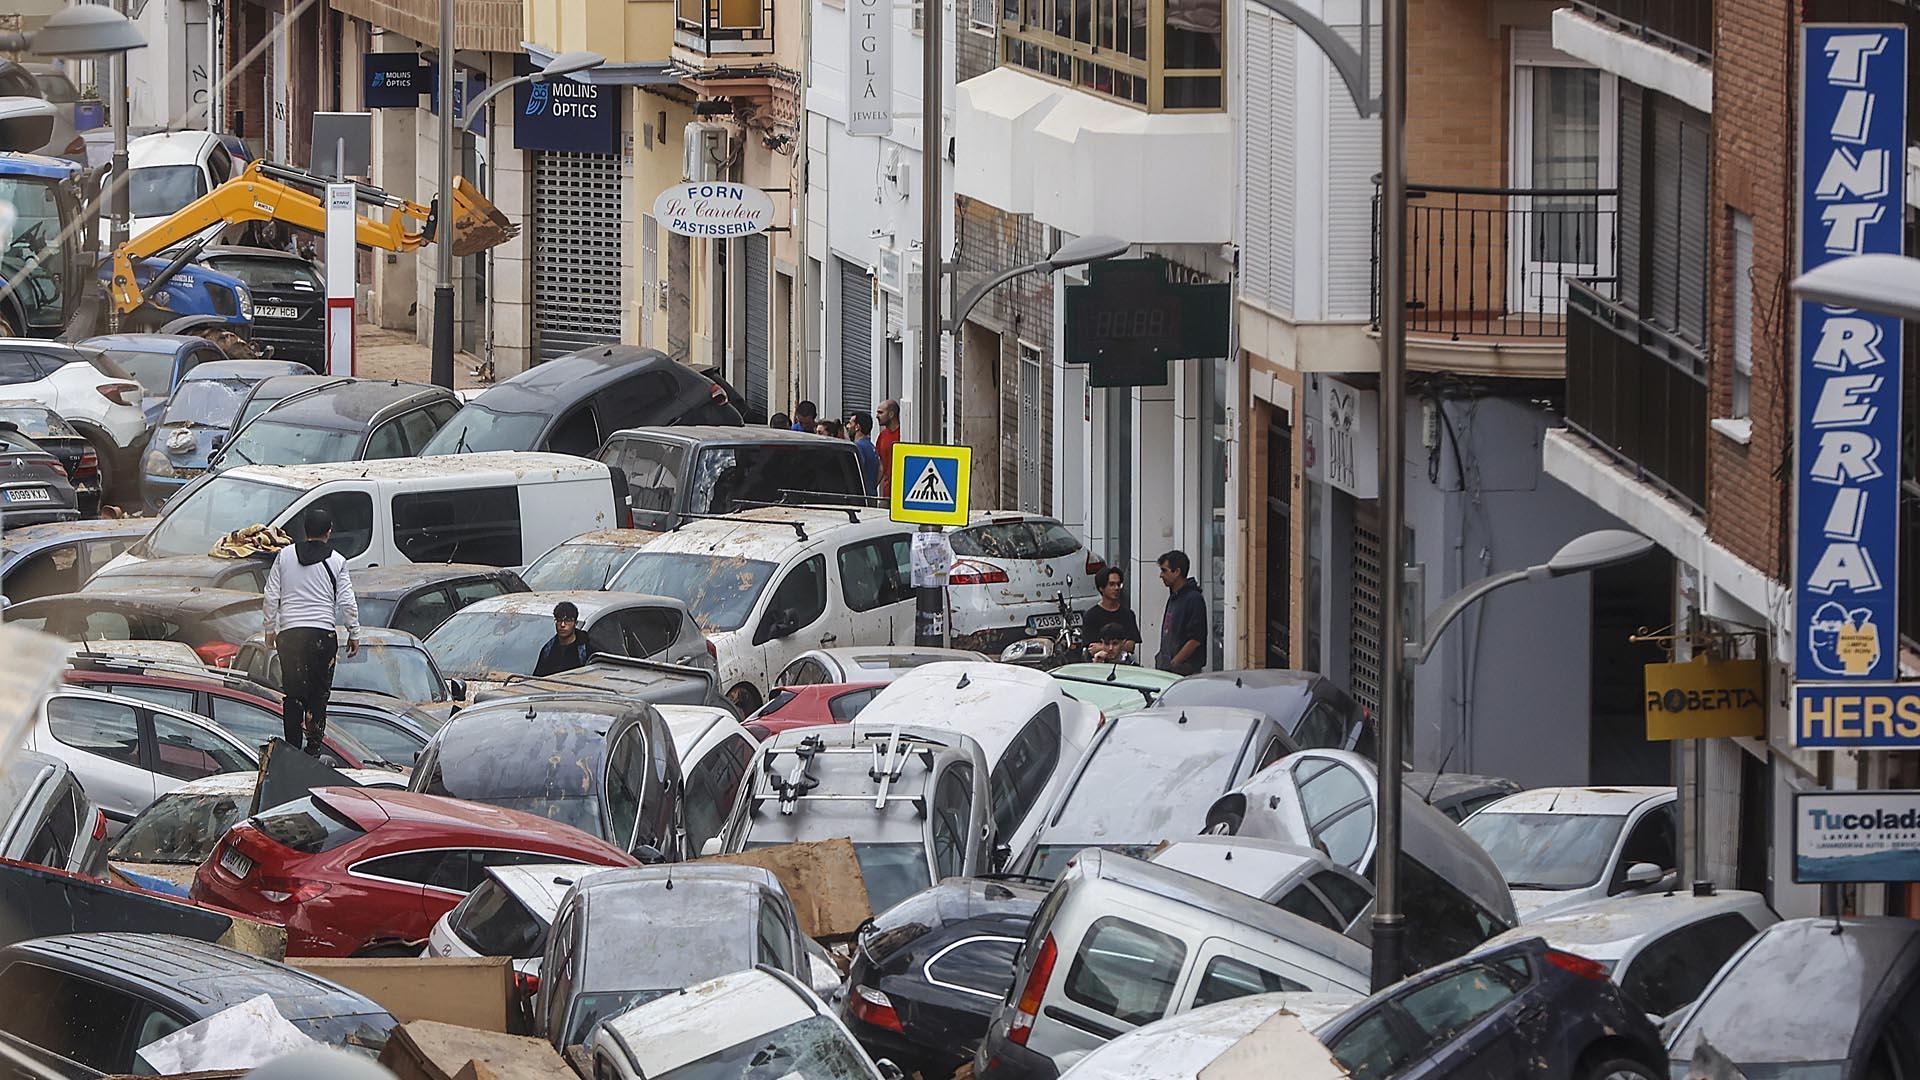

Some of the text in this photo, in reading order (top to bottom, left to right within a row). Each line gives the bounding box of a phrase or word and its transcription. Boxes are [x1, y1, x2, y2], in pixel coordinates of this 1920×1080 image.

[386, 71, 411, 79] MOLINS
[386, 79, 411, 87] ÒPTICS
[552, 83, 598, 98] MOLINS
[552, 99, 597, 118] ÒPTICS
[853, 111, 888, 122] JEWELS
[687, 186, 743, 200] FORN
[664, 199, 761, 219] La Carretera
[672, 218, 757, 235] PASTISSERIA
[256, 306, 296, 317] 7127 HCB
[1807, 34, 1889, 594] TINTRERIA
[9, 490, 31, 500] 8099
[1036, 616, 1062, 628] 2038
[1647, 688, 1761, 713] ROBERTA
[1802, 695, 1920, 737] HERS
